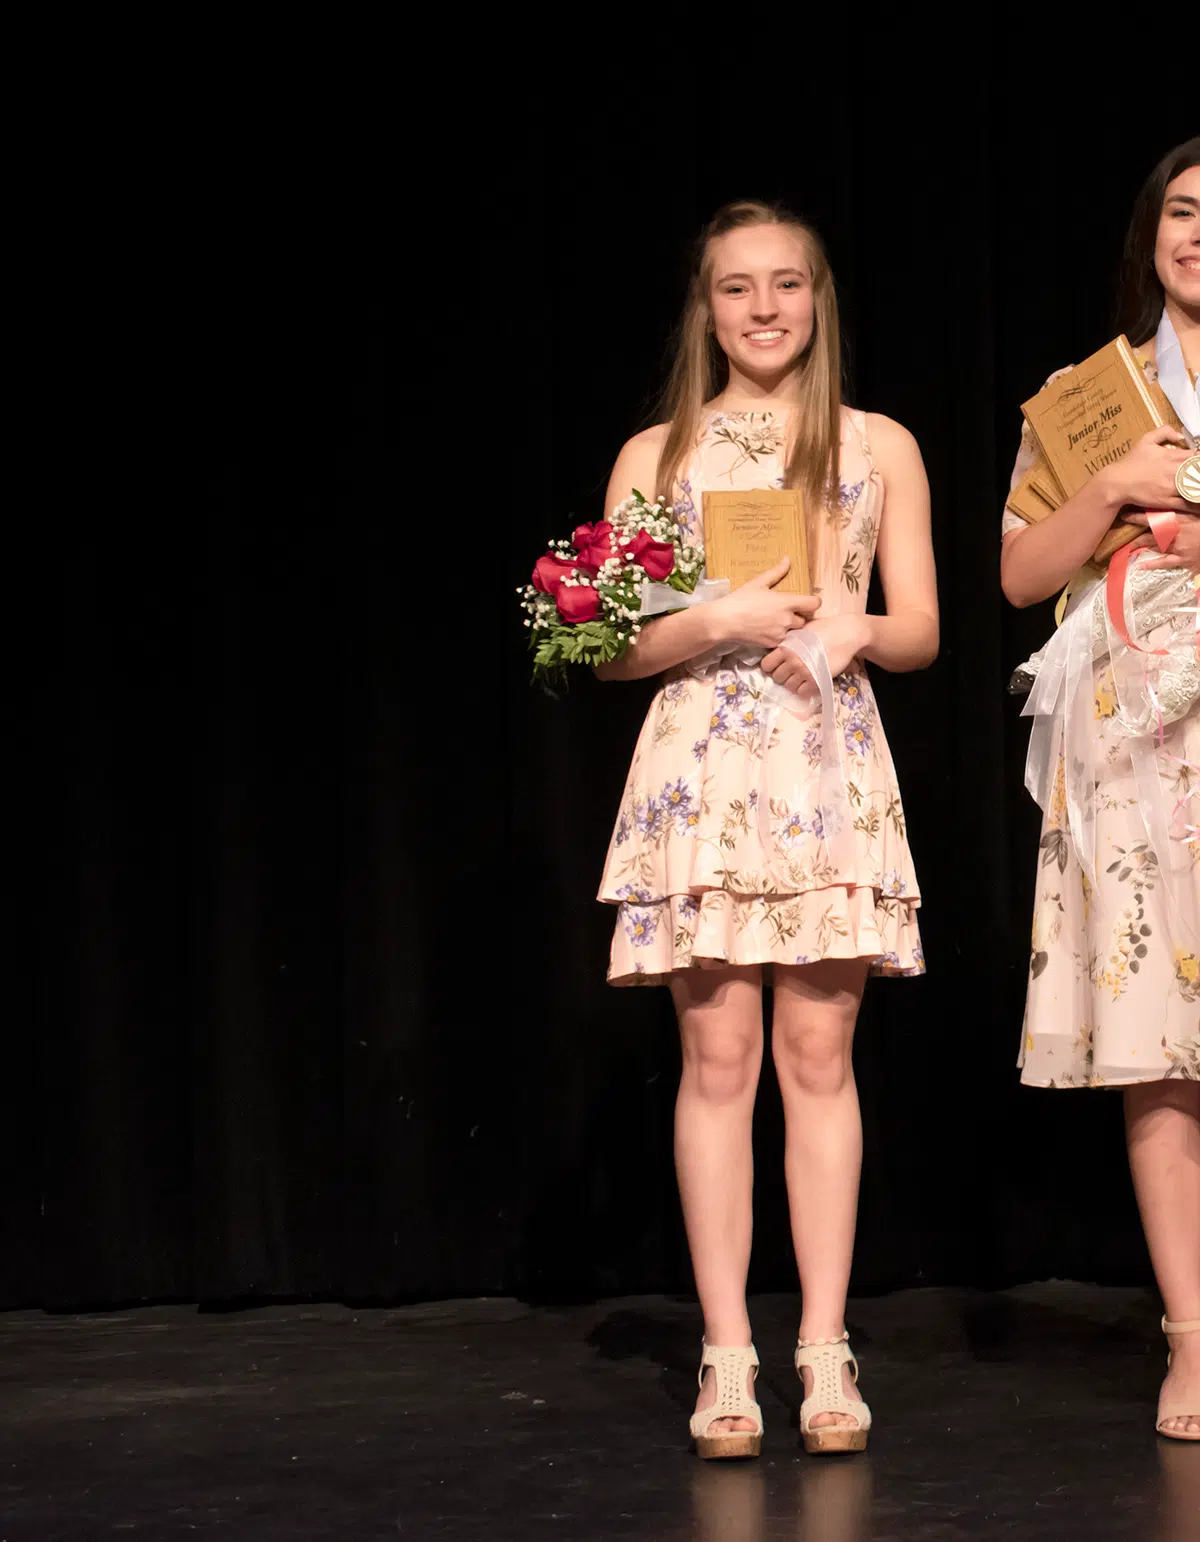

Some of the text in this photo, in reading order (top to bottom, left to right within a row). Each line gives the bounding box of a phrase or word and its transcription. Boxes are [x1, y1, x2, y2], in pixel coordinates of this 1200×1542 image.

[1067, 420, 1098, 450] Junior
[1099, 404, 1122, 425] Miss
[1084, 439, 1132, 476] Winner
